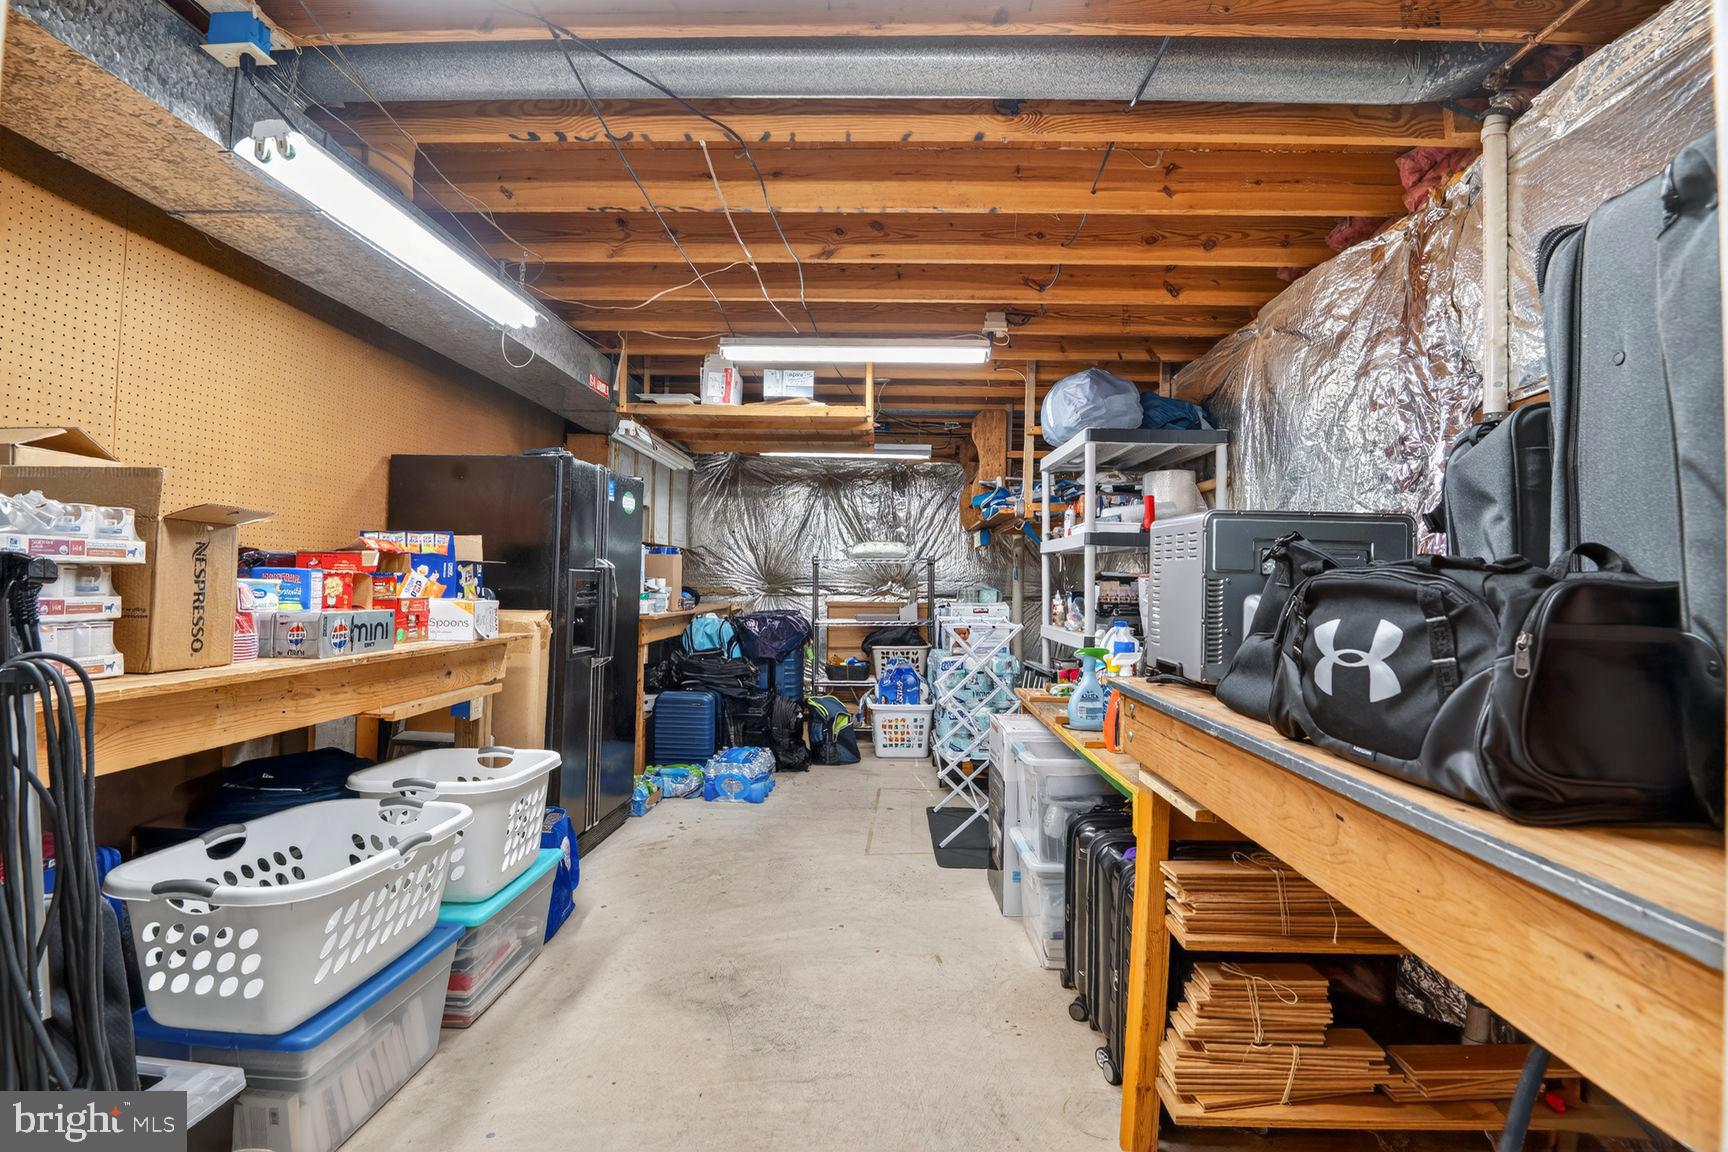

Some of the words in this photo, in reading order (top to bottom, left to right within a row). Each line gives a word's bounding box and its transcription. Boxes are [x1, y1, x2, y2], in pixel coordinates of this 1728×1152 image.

[190, 538, 210, 653] NESPRESSO
[352, 620, 390, 643] mini
[430, 617, 469, 629] Spoons
